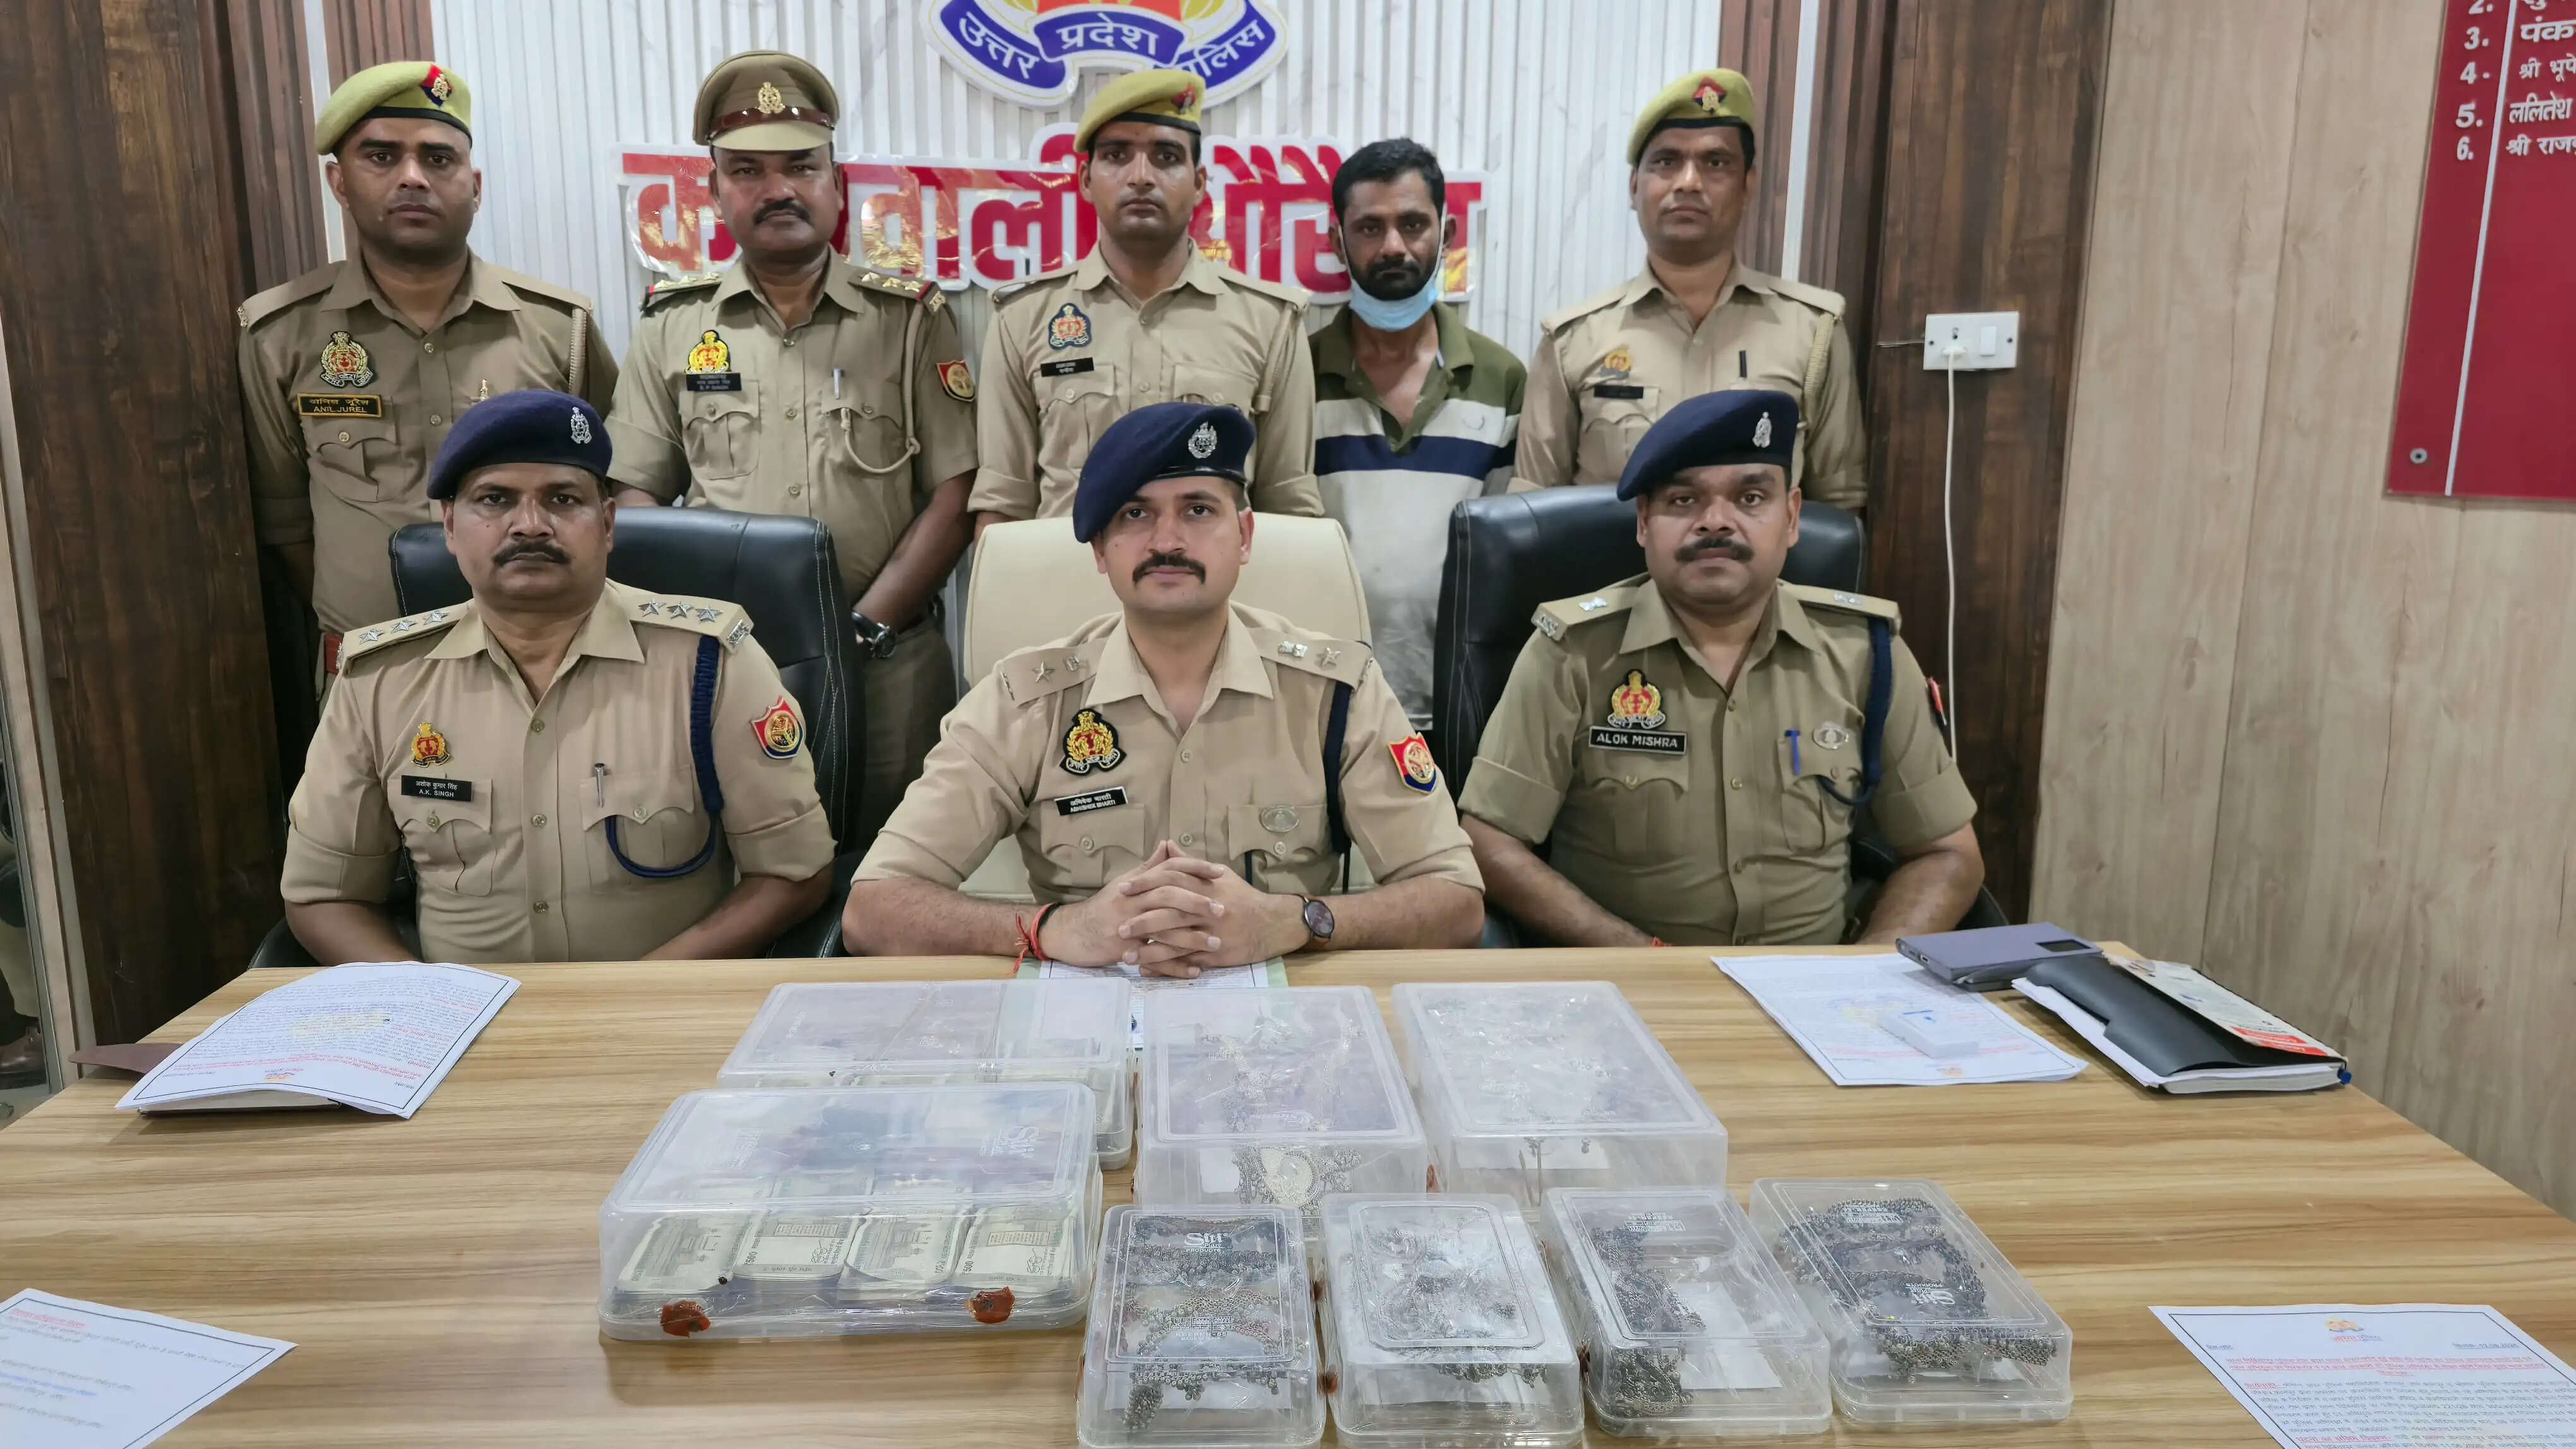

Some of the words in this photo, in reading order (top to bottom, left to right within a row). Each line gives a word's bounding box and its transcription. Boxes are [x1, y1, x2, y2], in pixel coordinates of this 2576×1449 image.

[958, 13, 1041, 80] उत्तर
[1056, 13, 1159, 56] प्रदेश
[2464, 27, 2489, 50] 3.
[2519, 57, 2541, 79] श्री
[2455, 100, 2483, 128] 5.
[2509, 91, 2573, 123] ललितेश
[2456, 136, 2474, 160] 6.
[2506, 134, 2532, 156] श्री
[1596, 733, 1628, 745] ALOK
[1632, 735, 1678, 748] MISHRA
[448, 782, 458, 790] सिंह
